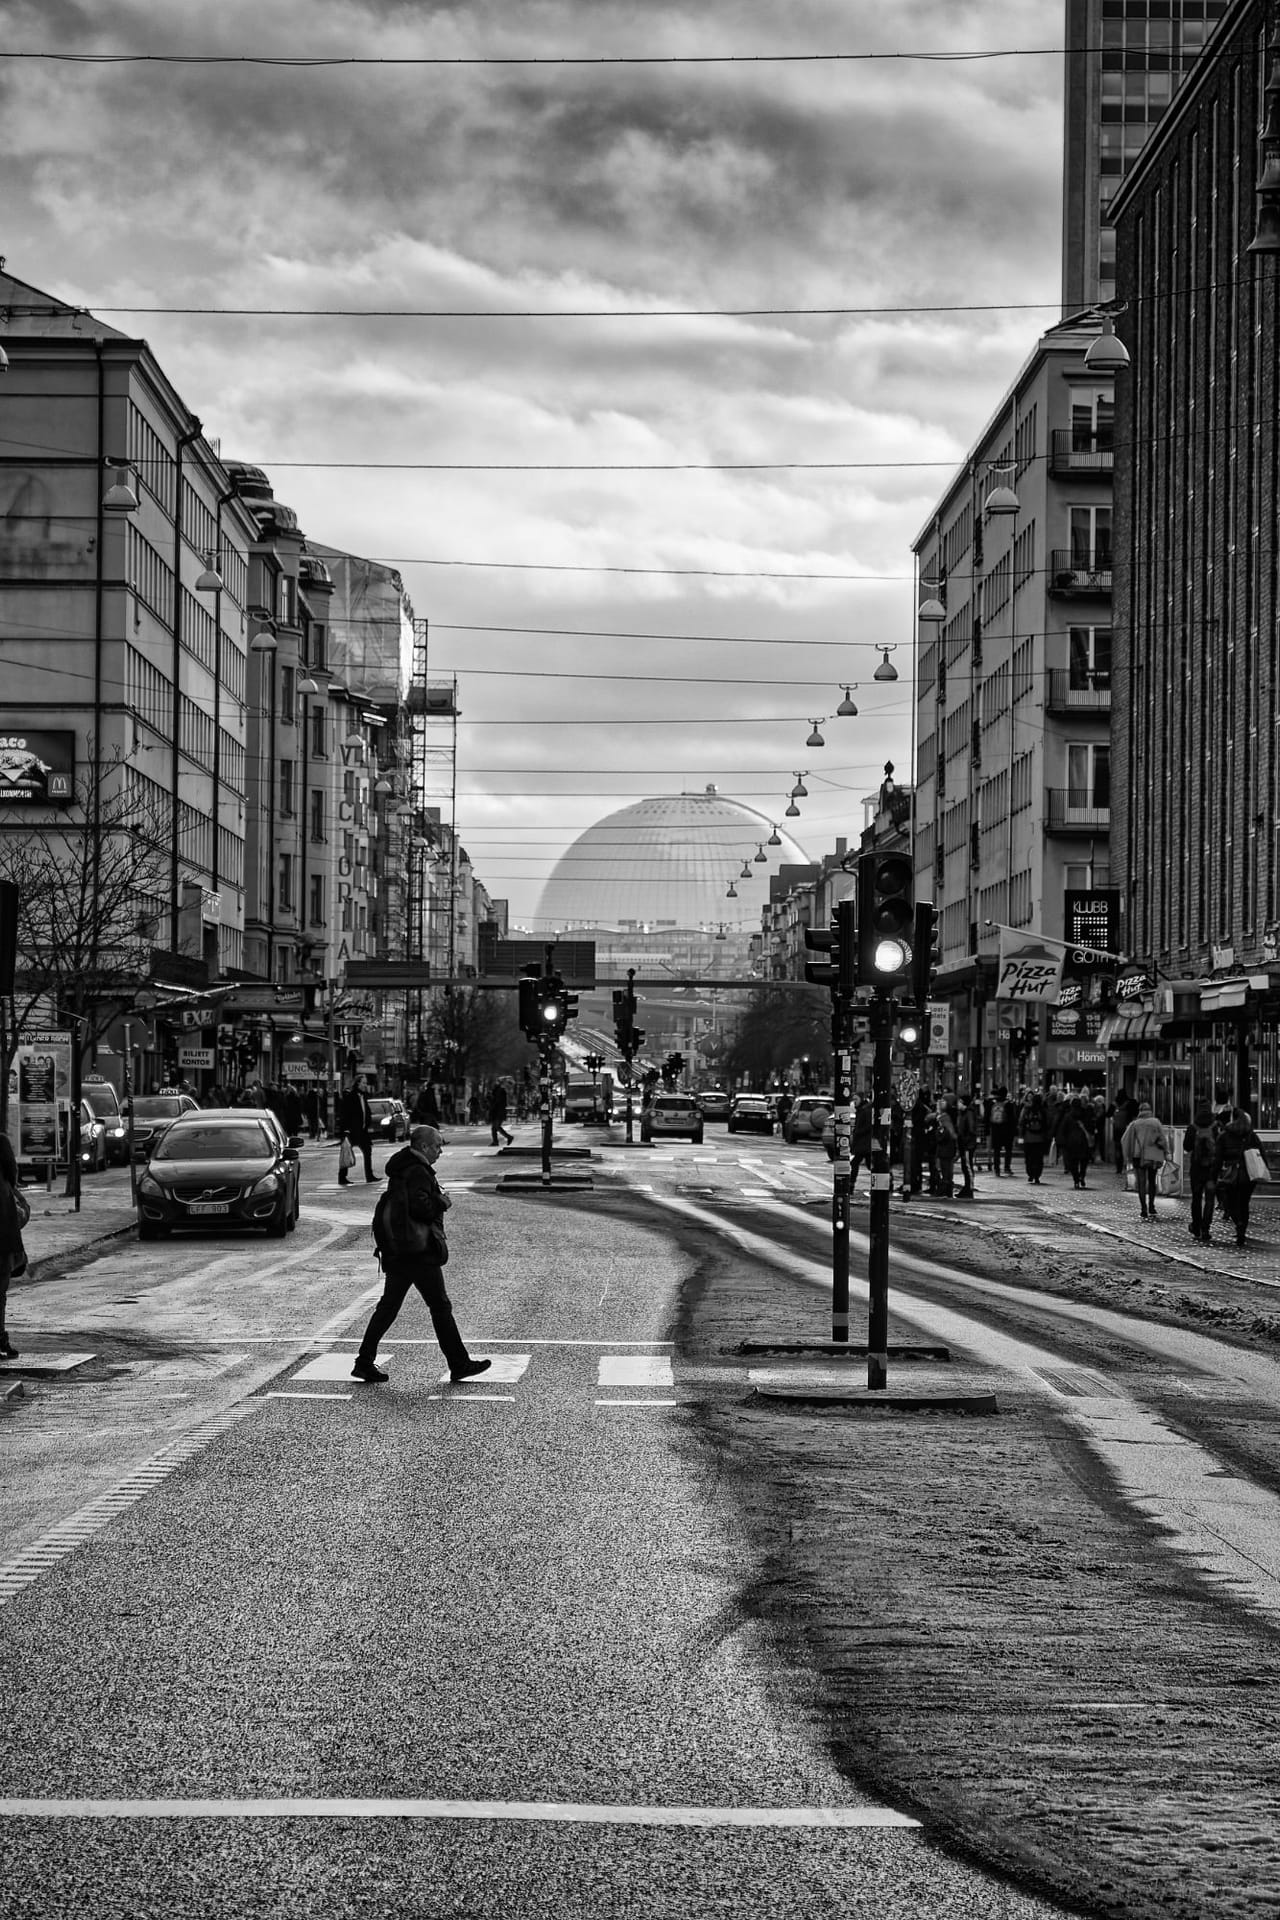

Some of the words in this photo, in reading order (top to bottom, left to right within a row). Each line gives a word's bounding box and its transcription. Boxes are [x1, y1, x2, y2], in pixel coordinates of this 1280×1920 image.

[1073, 900, 1109, 913] KLUBB
[1000, 961, 1057, 983] Pizza
[1009, 979, 1054, 999] Hut
[1115, 974, 1147, 993] Pizza
[1122, 983, 1143, 997] Hut
[1061, 992, 1079, 1004] Hut
